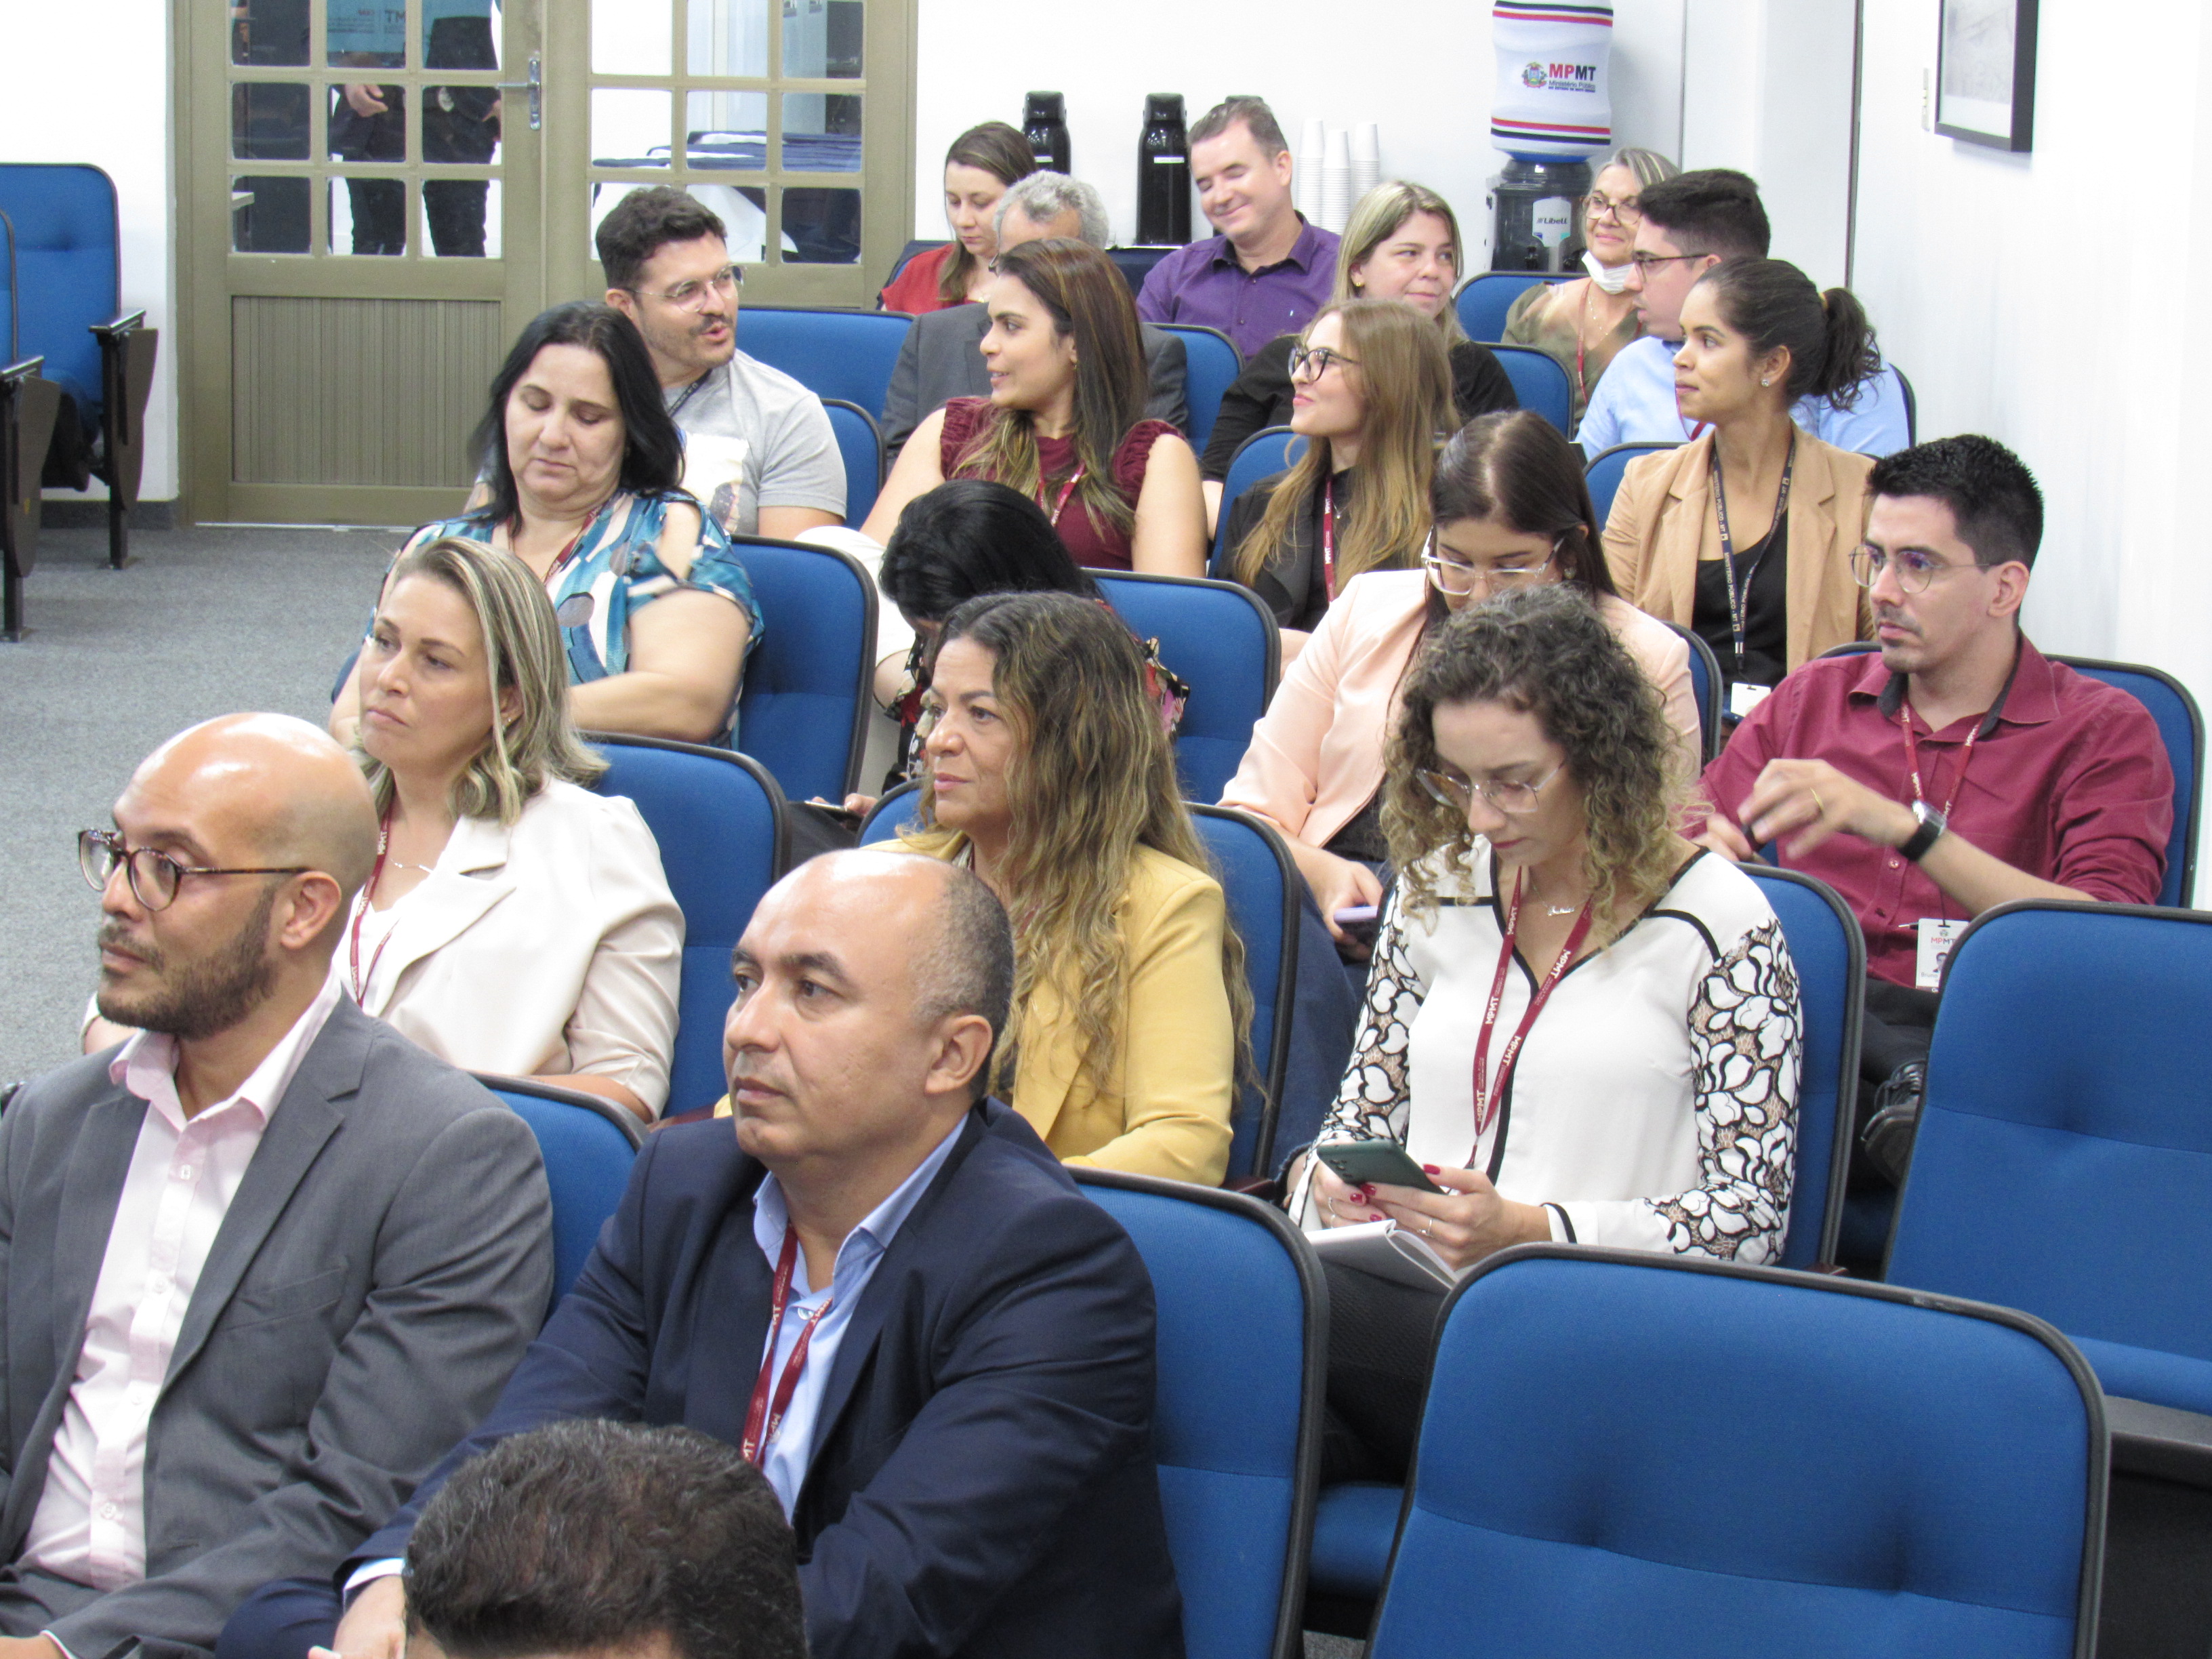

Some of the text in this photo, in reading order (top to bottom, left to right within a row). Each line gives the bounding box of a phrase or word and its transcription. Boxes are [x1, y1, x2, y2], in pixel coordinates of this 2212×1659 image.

[1549, 63, 1596, 81] MPMT
[1507, 906, 1518, 935] MPMT
[1551, 949, 1572, 979] MPMT
[1485, 996, 1499, 1025] MPMT
[1502, 1036, 1522, 1066] MPMT
[1476, 1090, 1486, 1122] MPMT
